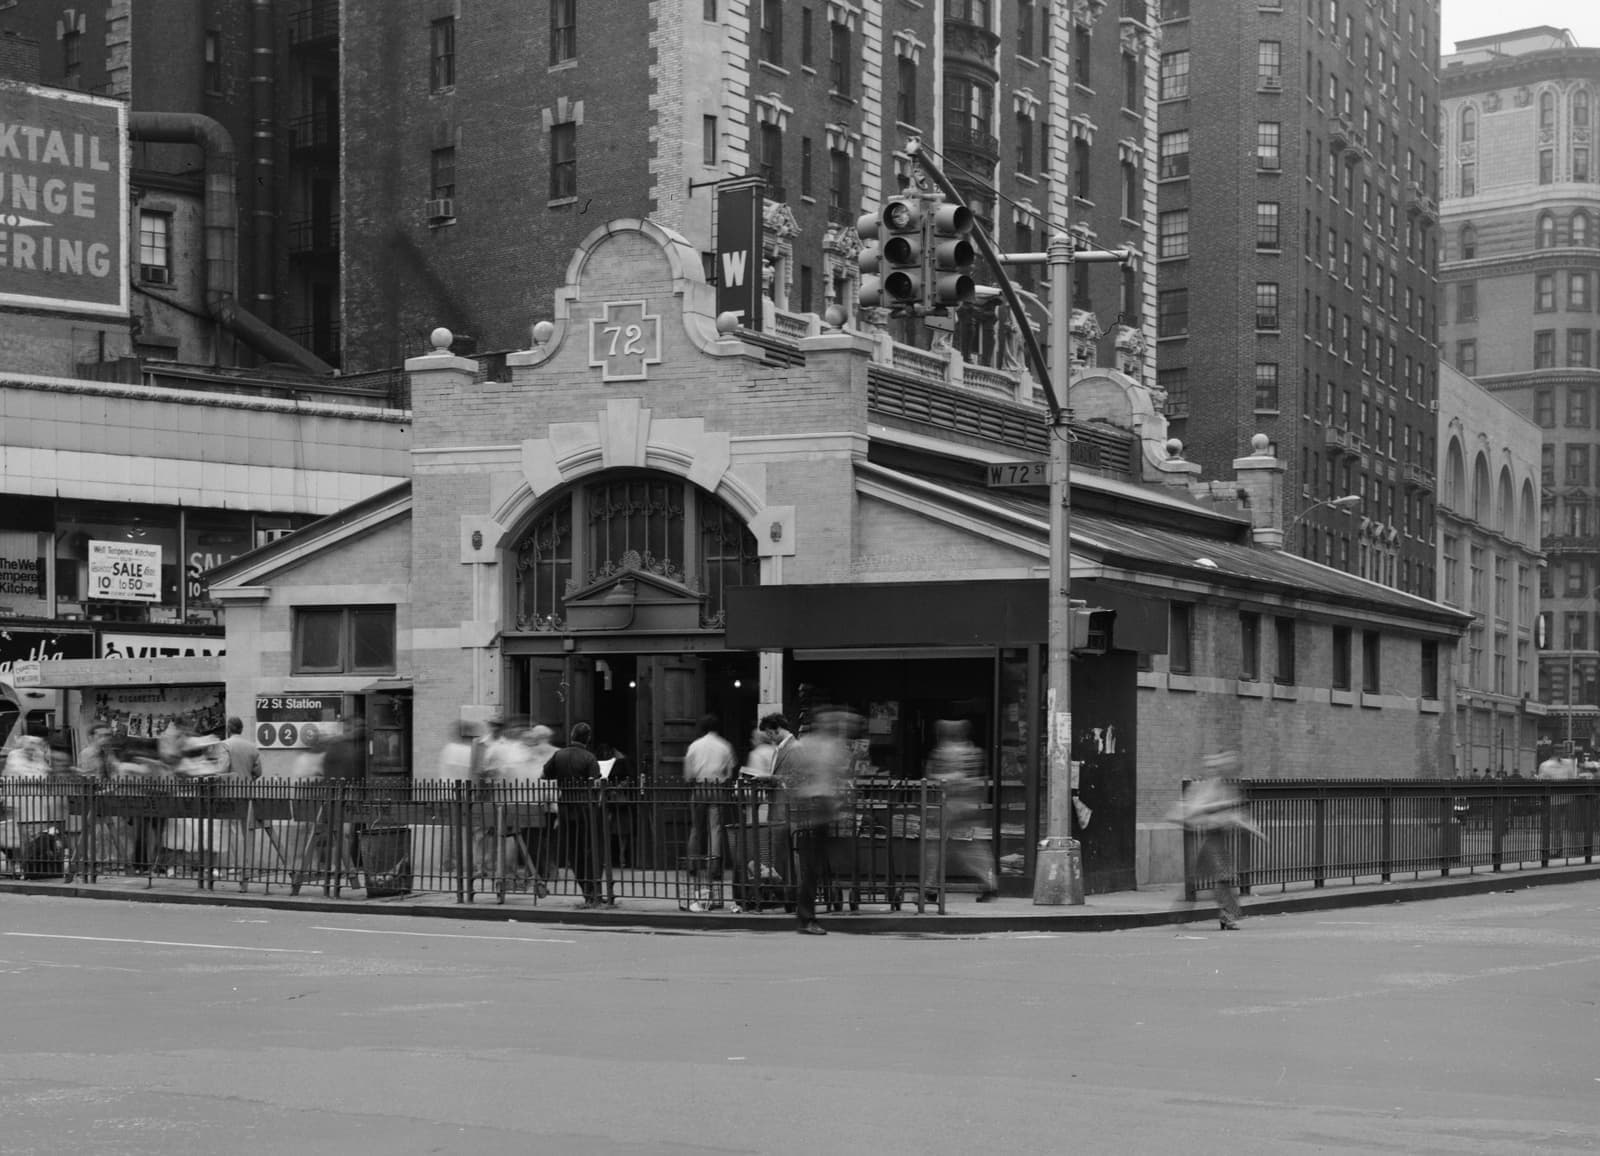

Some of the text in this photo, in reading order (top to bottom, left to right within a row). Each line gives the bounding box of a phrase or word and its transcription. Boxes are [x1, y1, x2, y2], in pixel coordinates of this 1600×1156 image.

[0, 122, 110, 172] KTAIL
[0, 172, 96, 219] NGE
[603, 324, 646, 357] 72
[991, 466, 1003, 485] W
[1008, 466, 1030, 484] 72
[18, 559, 40, 571] Wel
[112, 562, 143, 578] SALE
[190, 552, 240, 578] SA
[98, 576, 112, 589] 10
[128, 578, 144, 591] 50
[257, 698, 323, 709] 72 St Station
